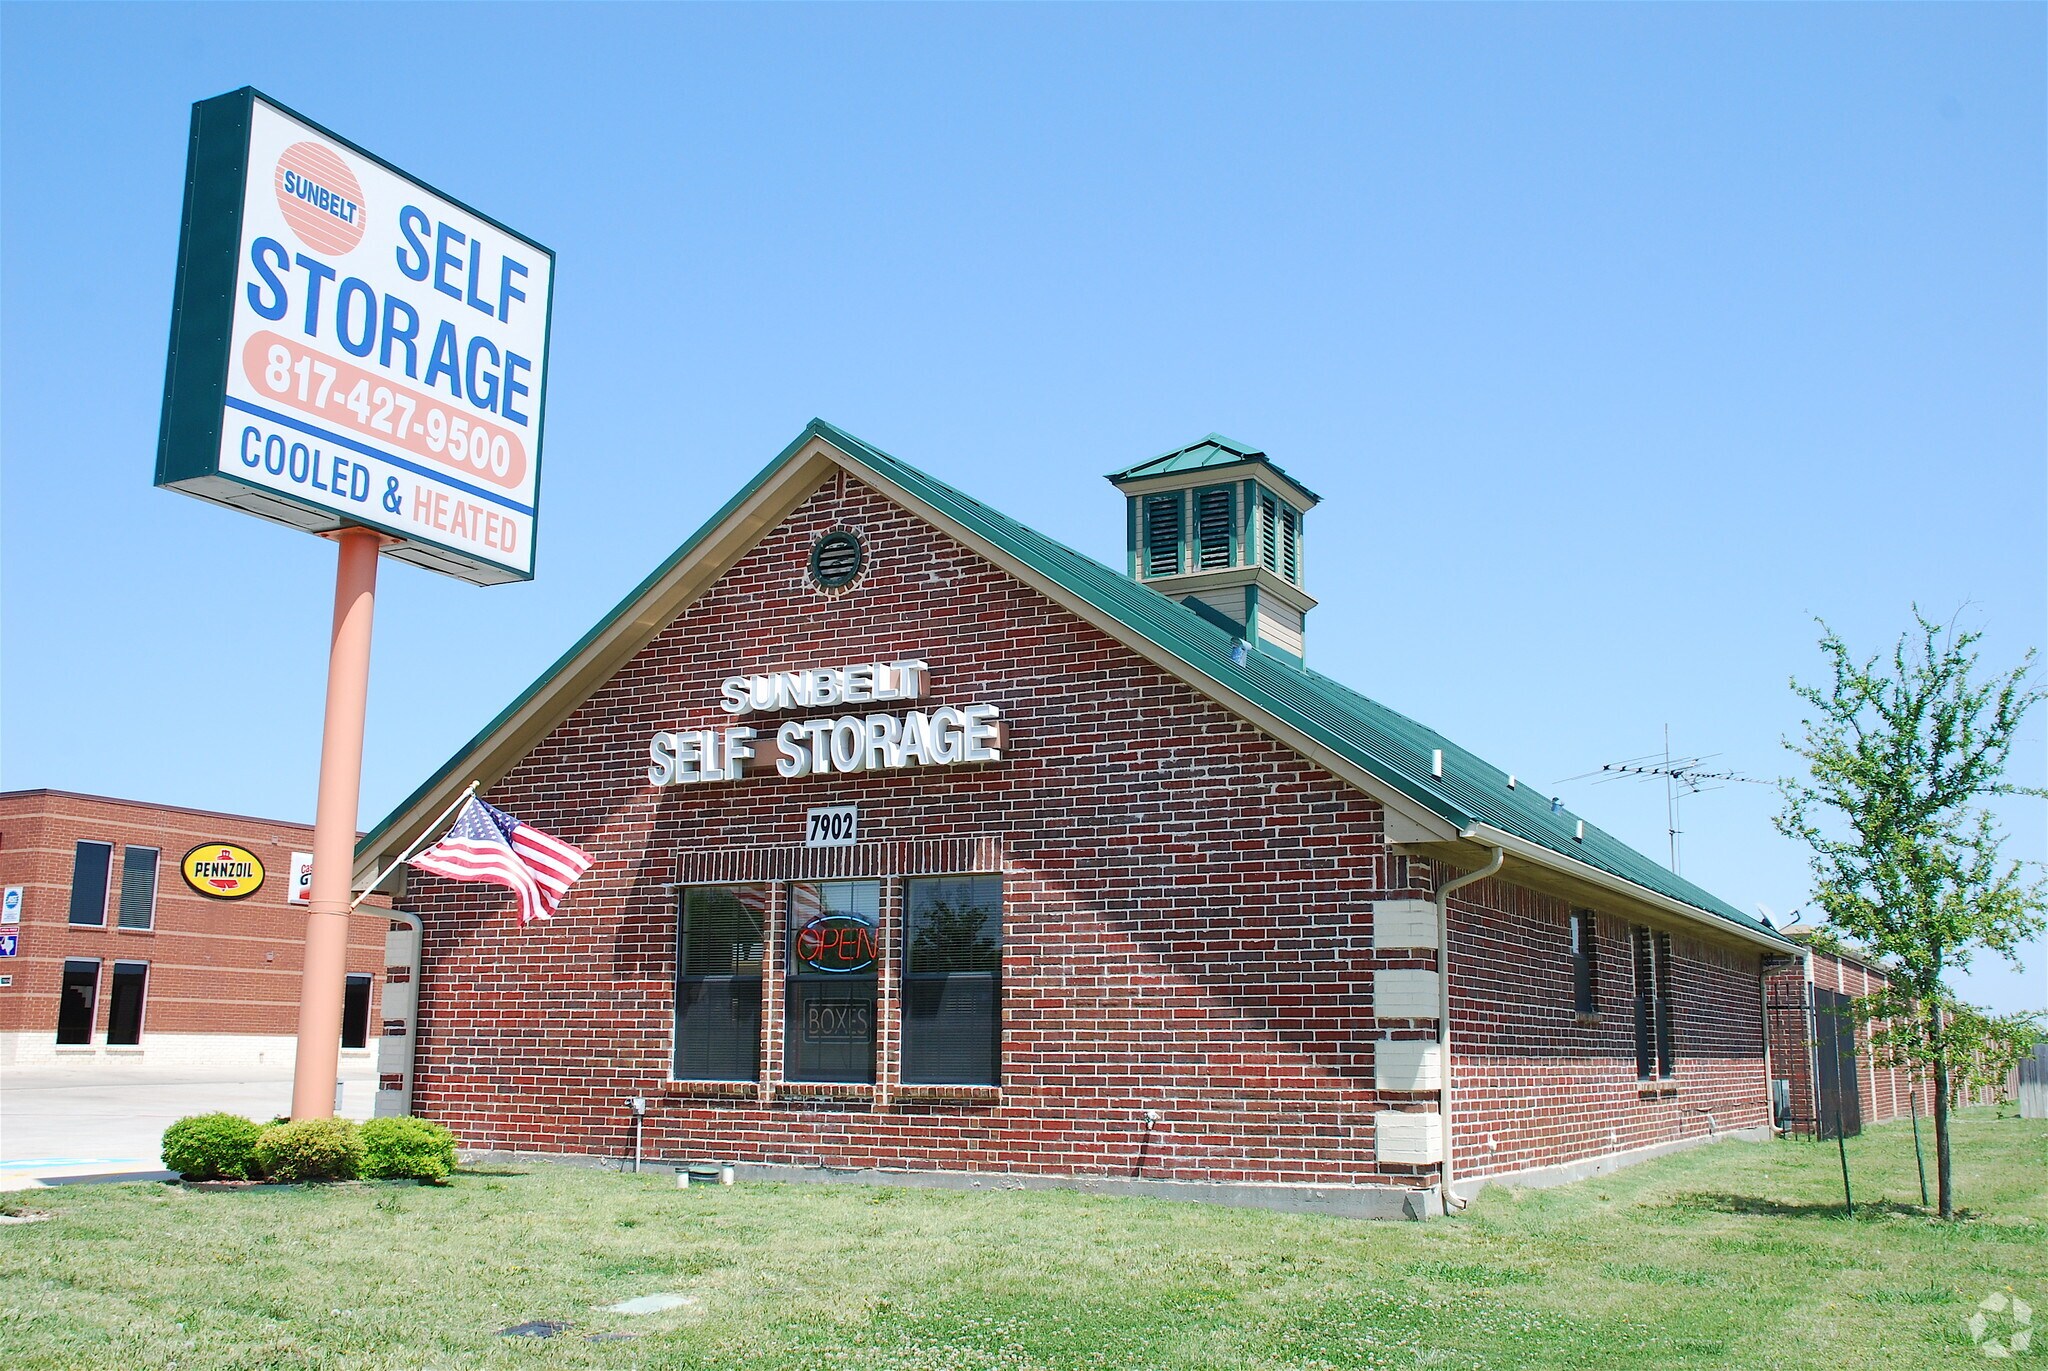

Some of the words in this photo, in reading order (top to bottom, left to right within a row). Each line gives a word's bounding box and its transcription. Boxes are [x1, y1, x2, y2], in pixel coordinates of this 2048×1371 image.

[284, 169, 358, 224] SUNBELT
[396, 204, 529, 324] SELF
[246, 236, 532, 427] STORAGE
[264, 343, 511, 478] 817-427-9500
[241, 426, 371, 503] COOLED
[382, 475, 402, 515] &
[413, 485, 518, 554] HEATED
[720, 660, 928, 714] SUNBELT
[648, 727, 757, 786] SELF
[776, 704, 1000, 778] STORAGE
[809, 812, 853, 842] 7902
[194, 862, 253, 878] PENNZOIL
[797, 927, 880, 961] OPEN
[808, 1008, 868, 1034] BOXES
